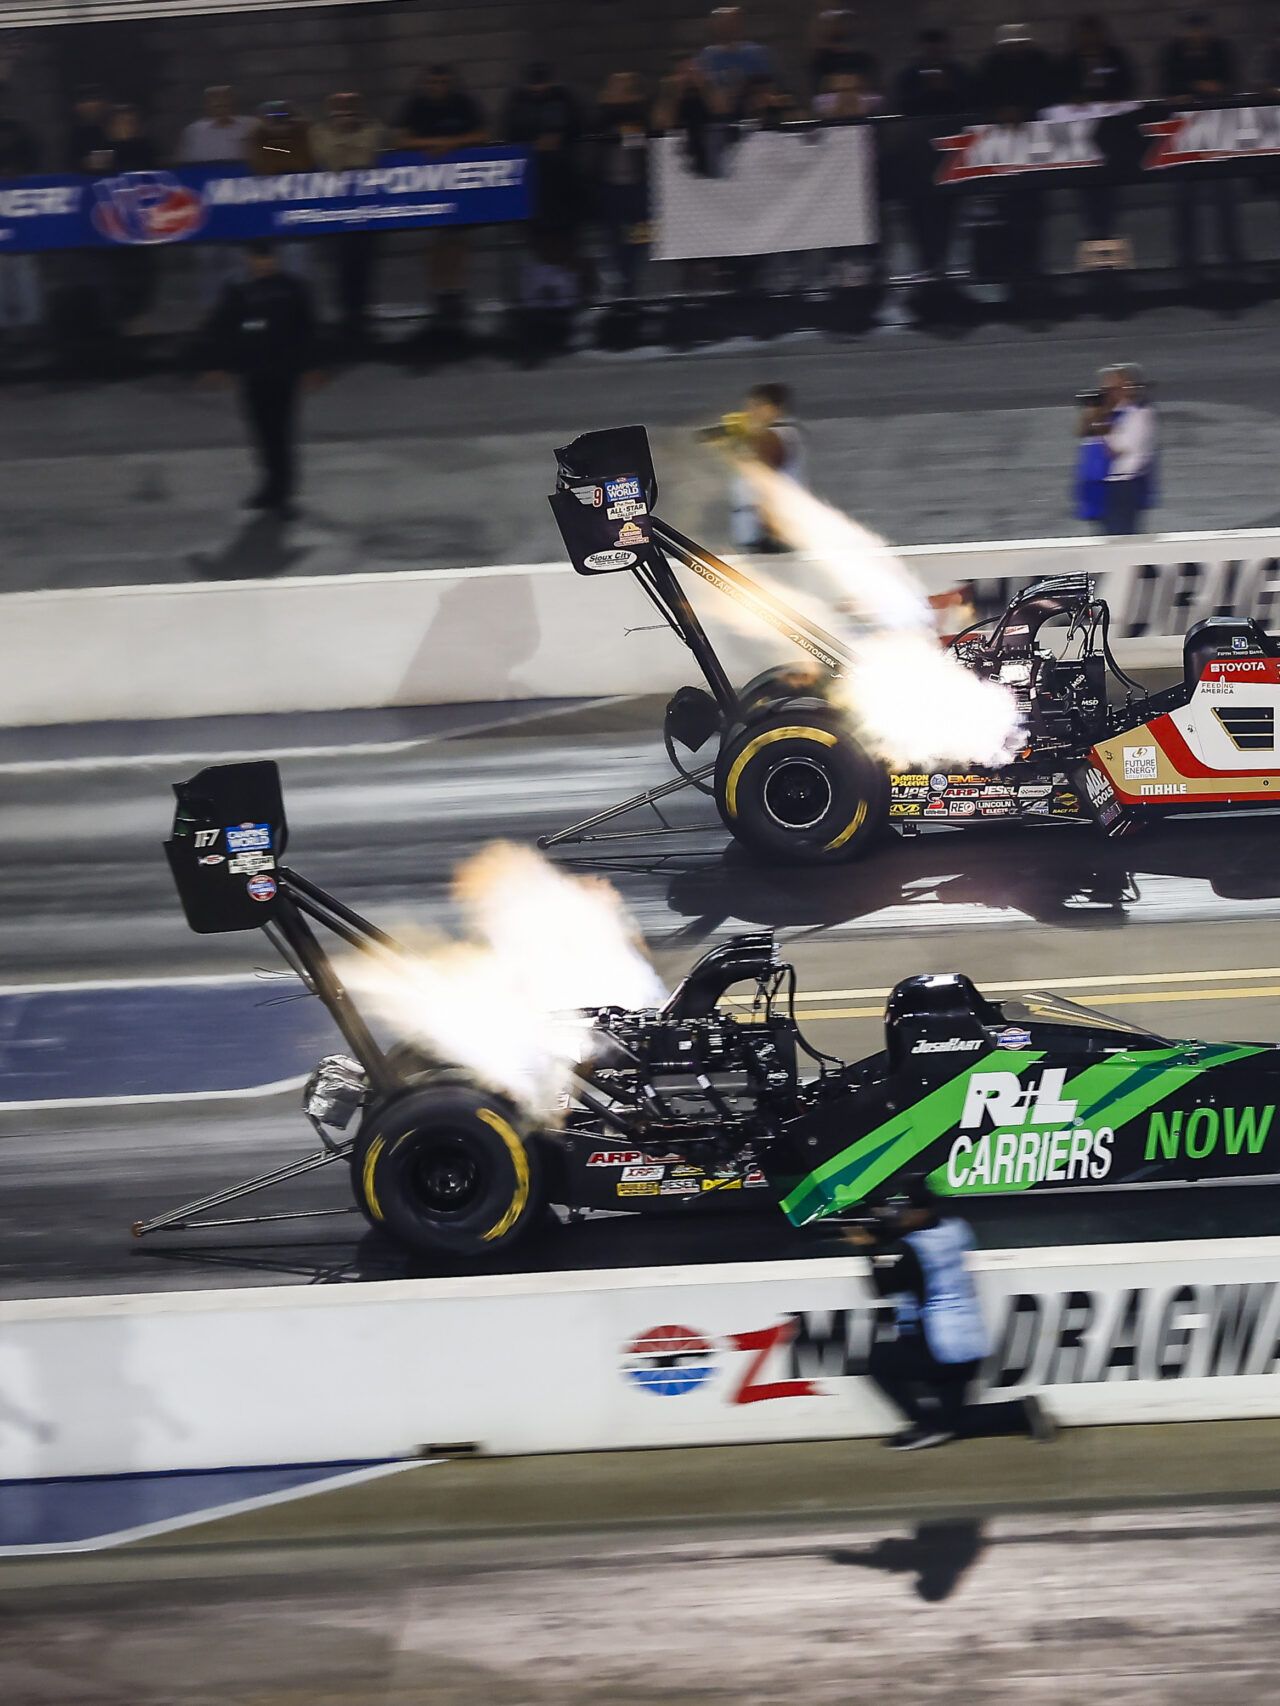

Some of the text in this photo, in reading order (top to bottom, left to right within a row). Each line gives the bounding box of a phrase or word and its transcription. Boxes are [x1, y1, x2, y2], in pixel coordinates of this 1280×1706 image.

[593, 488, 602, 507] 9
[608, 487, 639, 498] WORLD
[589, 552, 632, 562] Sioux City
[799, 640, 838, 668] AUTODESK
[1219, 662, 1266, 672] TOYOTA
[1125, 759, 1155, 767] FUTURE
[1125, 767, 1156, 775] ENERGY
[1085, 767, 1110, 801] MAC
[944, 788, 977, 796] ARP
[980, 786, 1018, 796] JESEL
[1140, 784, 1188, 796] MAHLE
[1092, 786, 1115, 808] TOOLS
[978, 800, 1012, 808] LINCOLN
[1144, 1104, 1276, 1161] NOW
[591, 1152, 640, 1163] ARP
[947, 1126, 1114, 1188] CARRIERS
